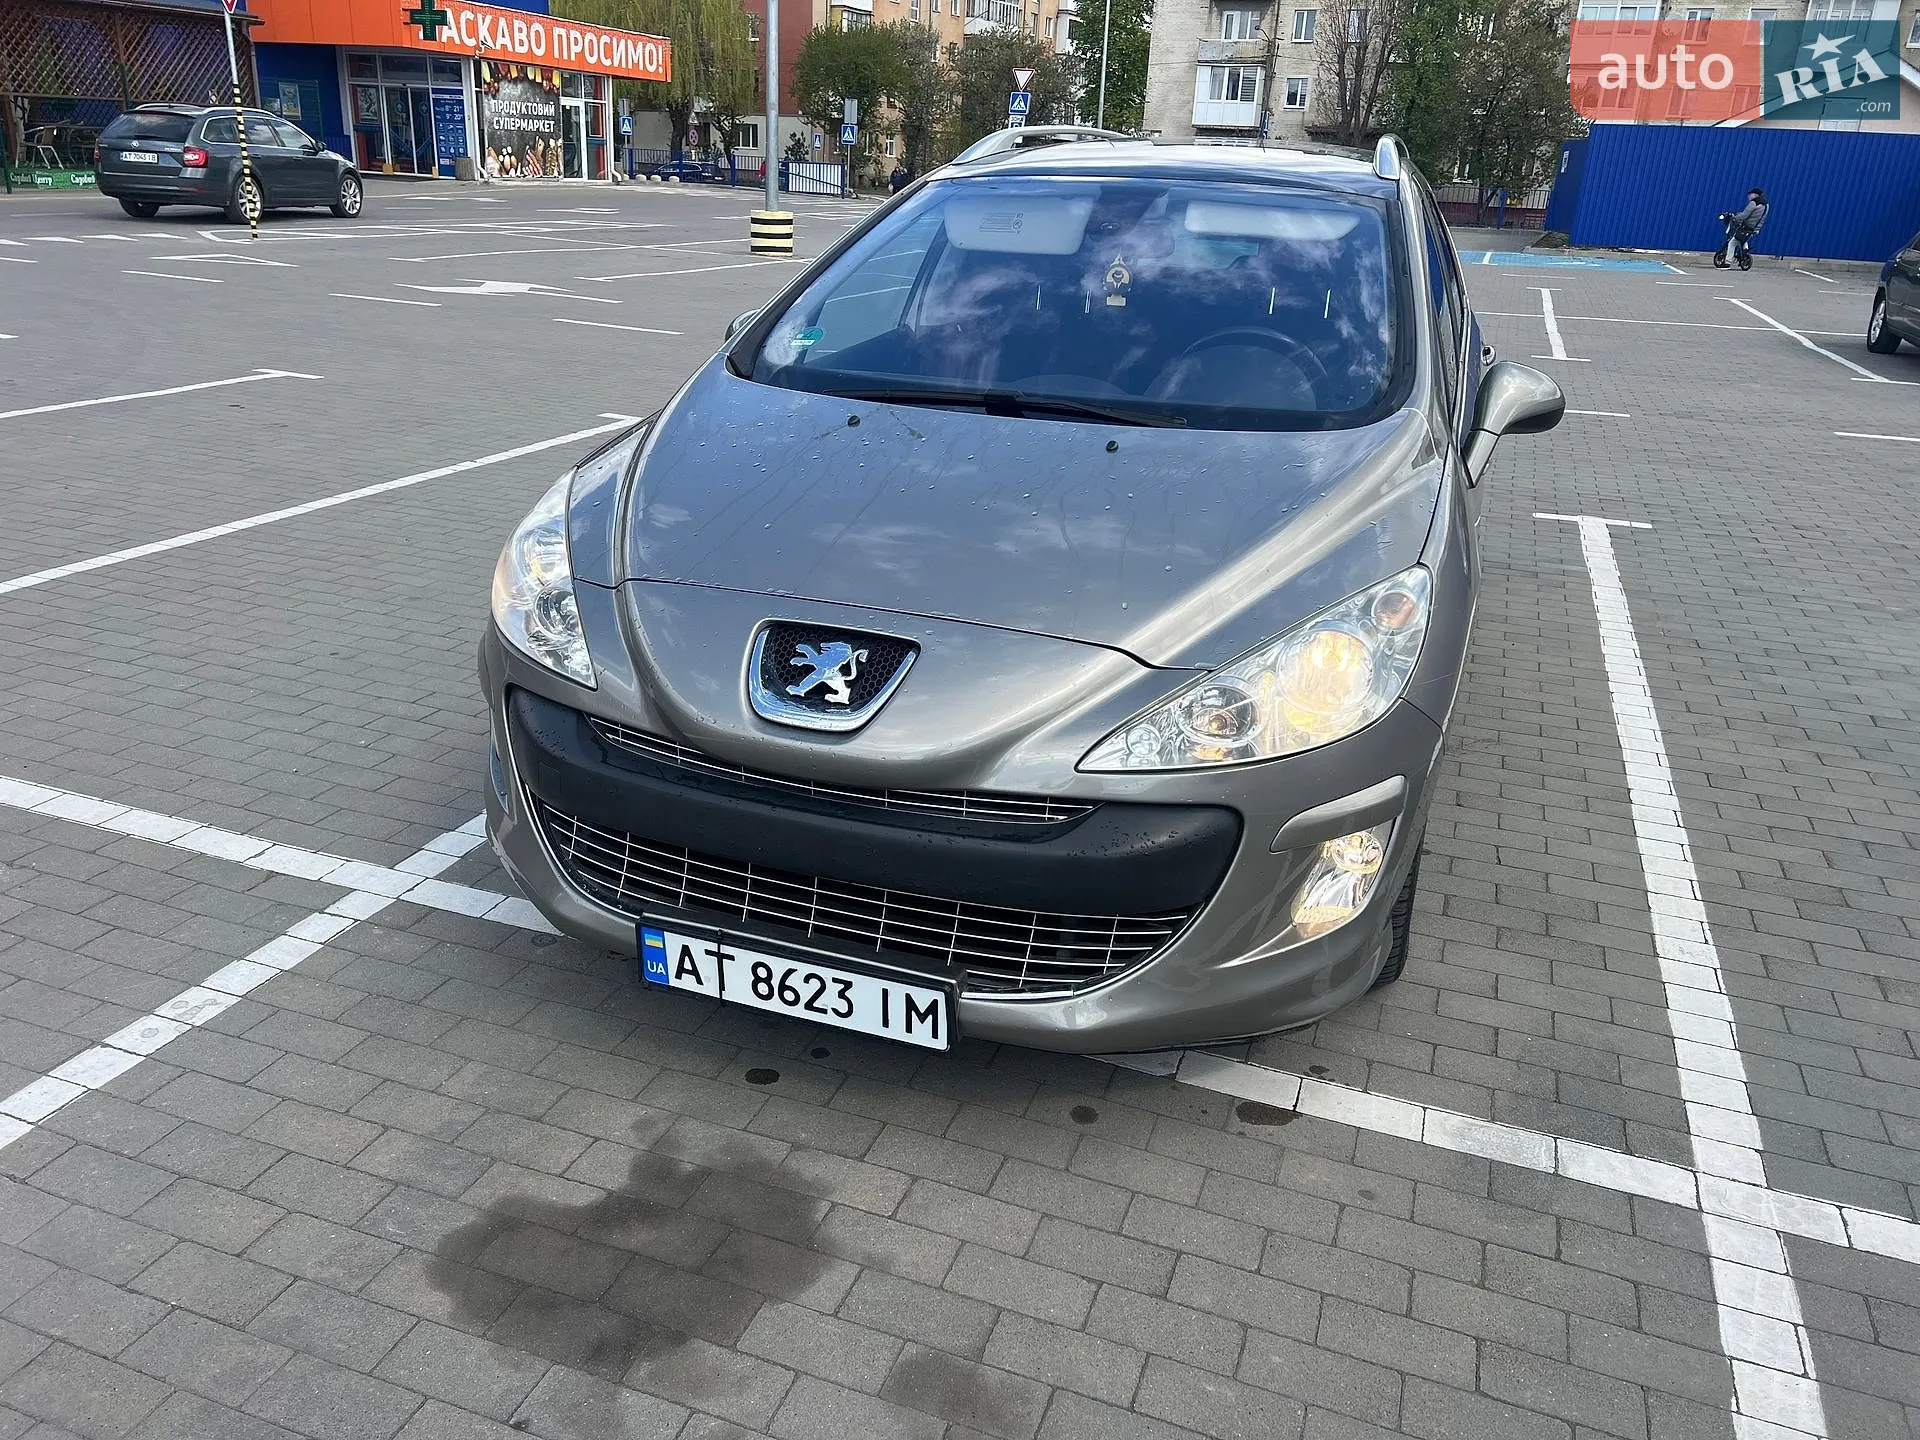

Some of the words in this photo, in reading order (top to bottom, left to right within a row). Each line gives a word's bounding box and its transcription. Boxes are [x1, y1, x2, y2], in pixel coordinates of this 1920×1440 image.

[419, 7, 546, 57] АСКАВО
[552, 26, 664, 74] ПРОСИМО!
[491, 99, 555, 117] ПРОДУКТОВИЙ
[493, 117, 555, 133] СУПЕРМАРКЕТ
[647, 959, 666, 976] UA
[674, 944, 736, 992] AT
[751, 961, 854, 1019] 8623
[881, 987, 940, 1040] IM
